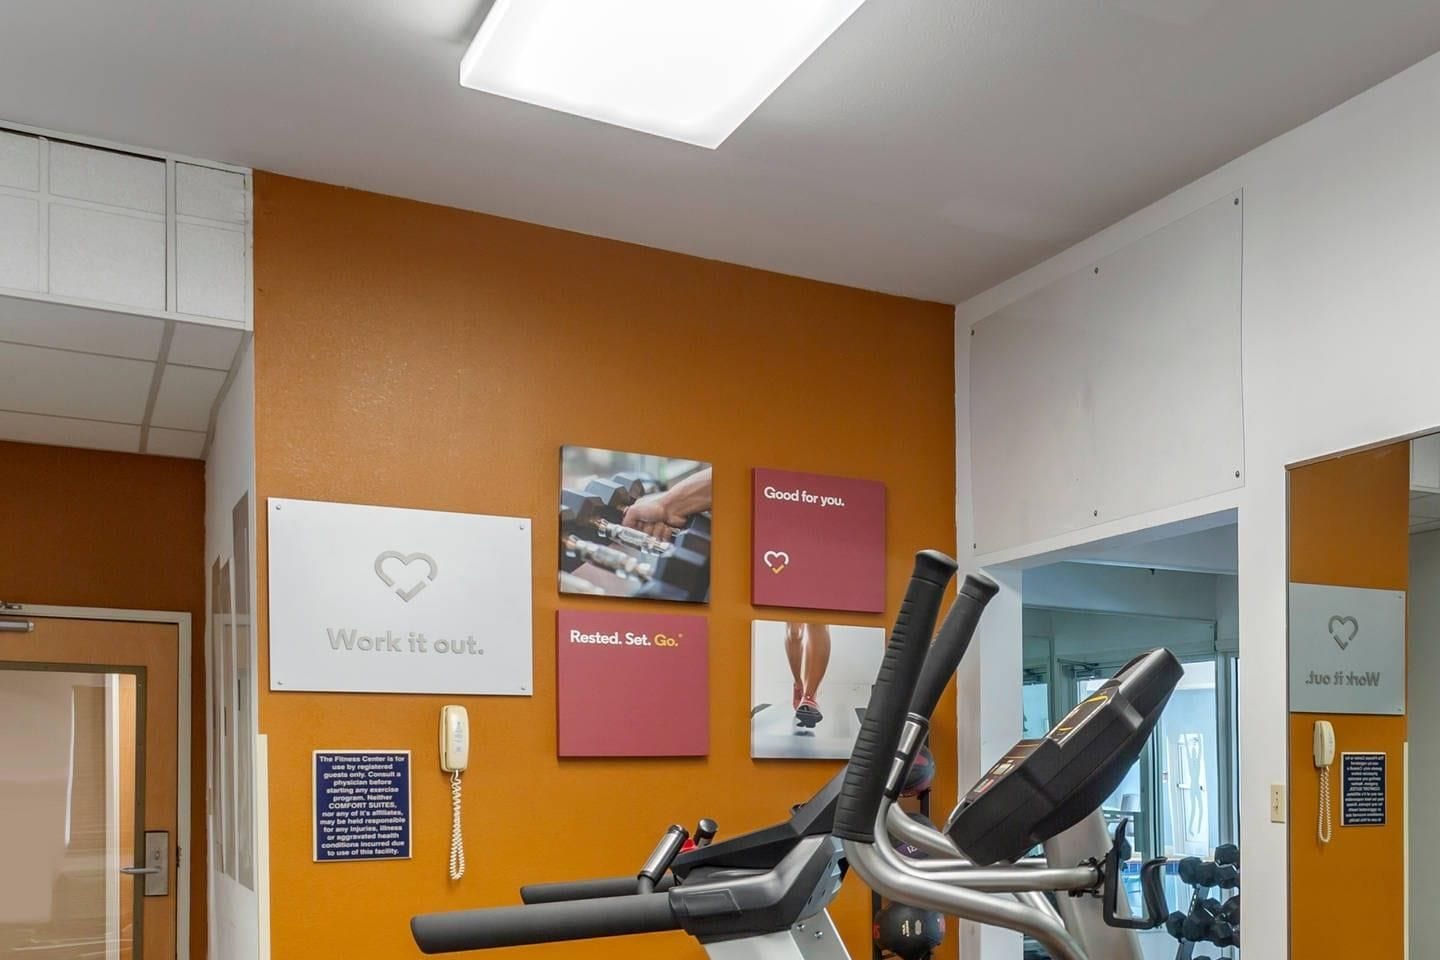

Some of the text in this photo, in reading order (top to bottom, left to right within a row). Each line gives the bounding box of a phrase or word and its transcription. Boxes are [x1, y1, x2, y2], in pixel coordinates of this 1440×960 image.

[764, 486, 845, 507] Good for you.
[326, 628, 484, 655] Work it out.
[570, 629, 622, 645] Rested.
[625, 632, 651, 646] Set.
[337, 833, 376, 841] aggravated
[321, 841, 359, 849] conditions
[375, 848, 399, 856] facility.
